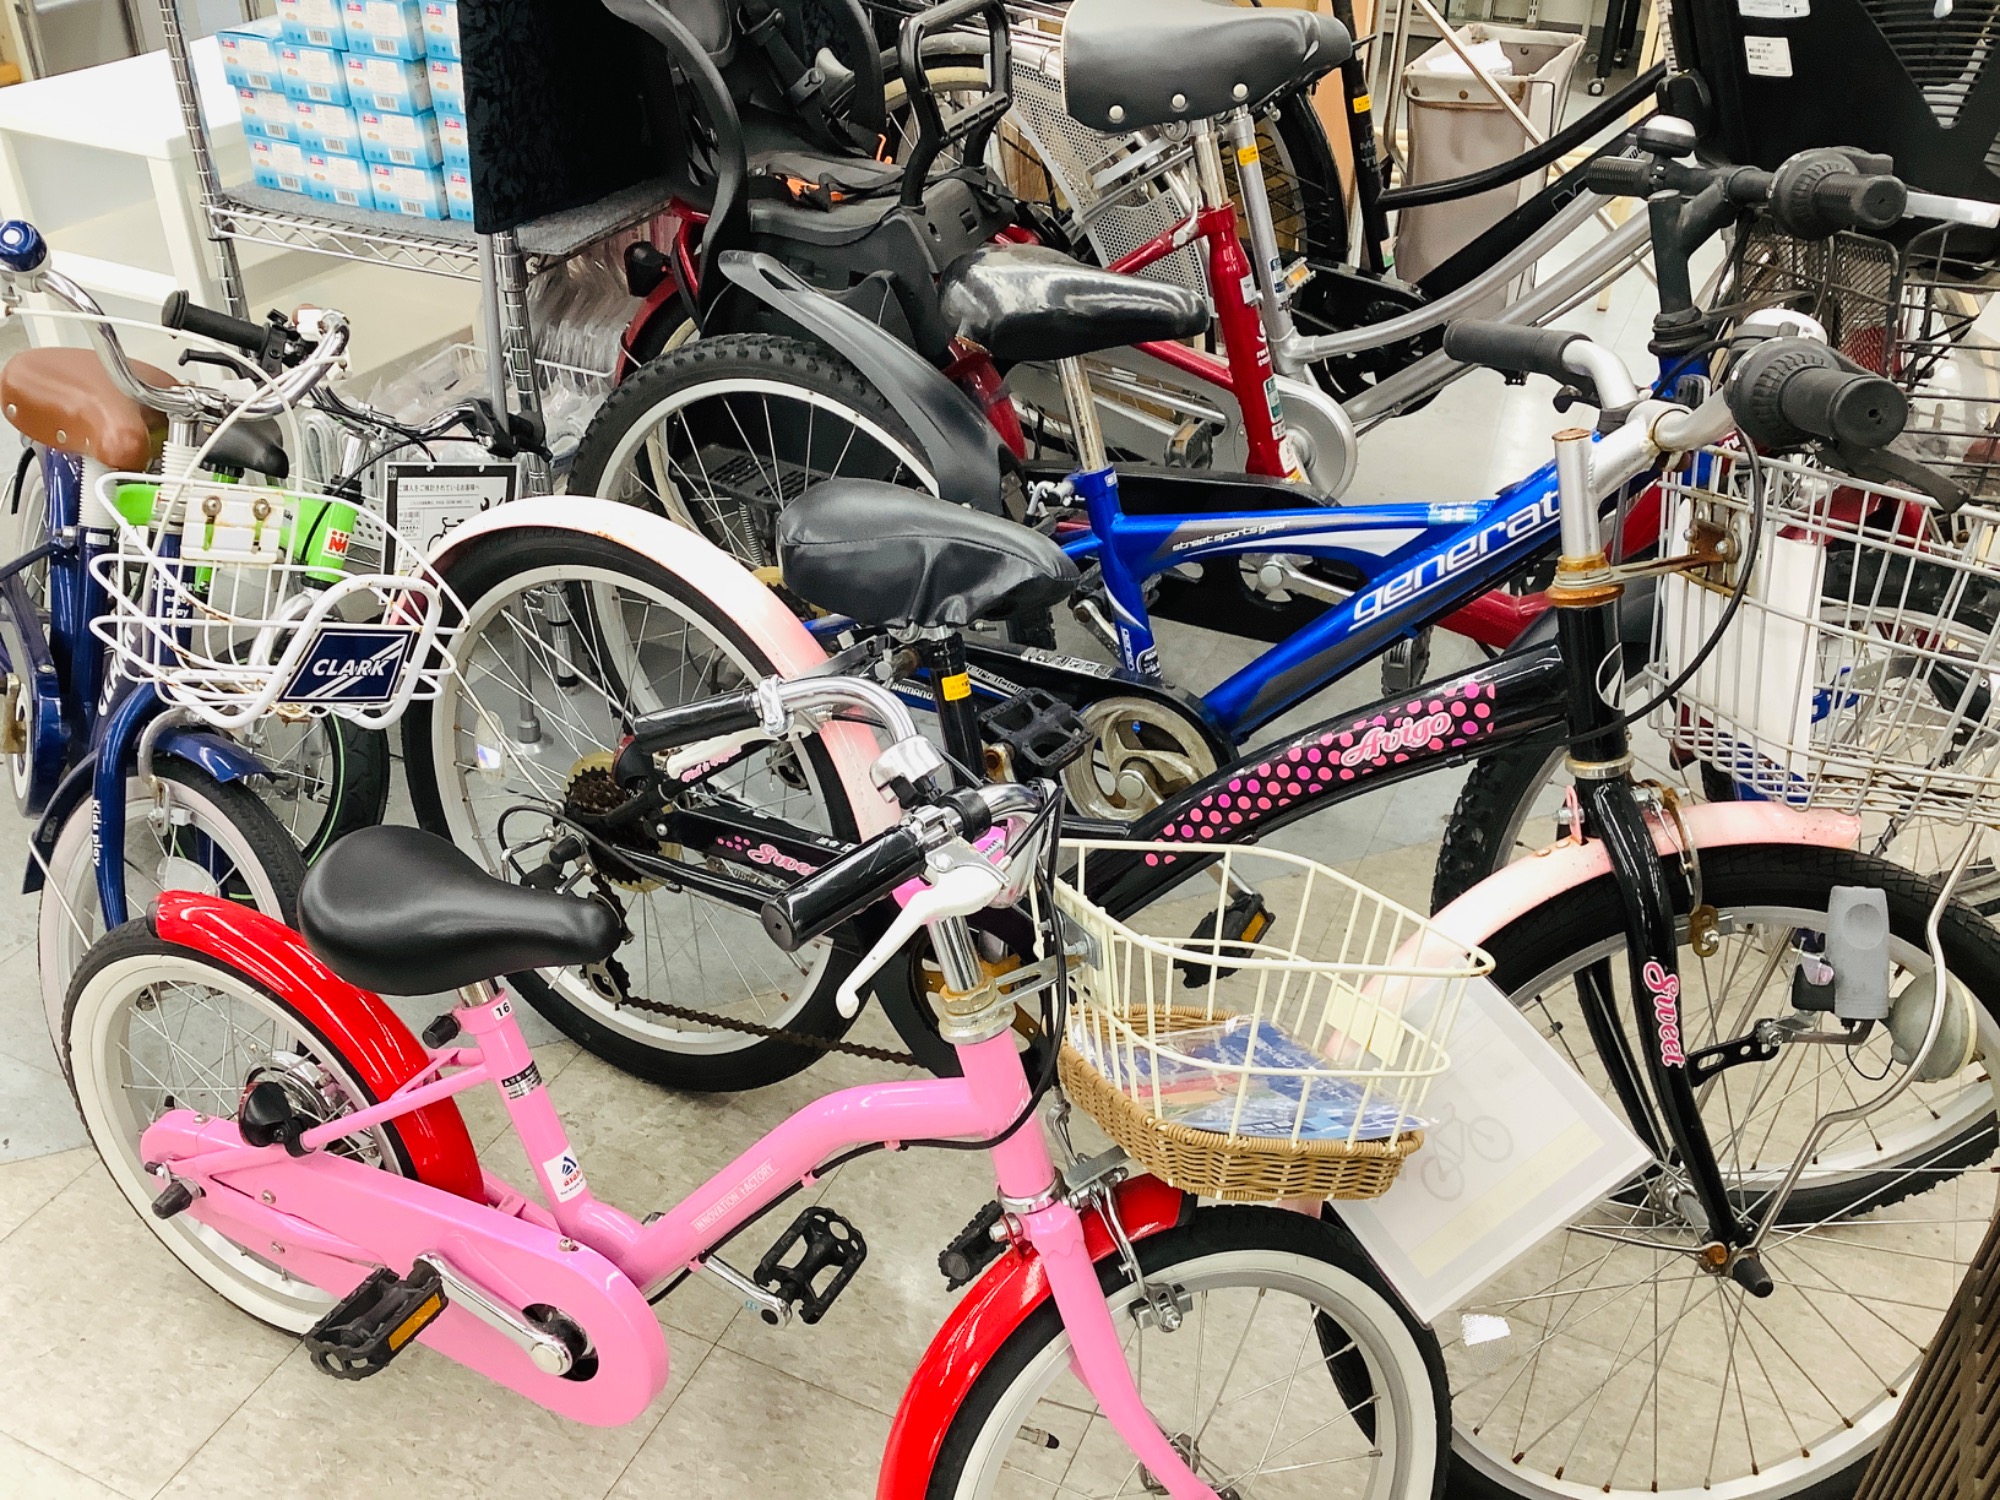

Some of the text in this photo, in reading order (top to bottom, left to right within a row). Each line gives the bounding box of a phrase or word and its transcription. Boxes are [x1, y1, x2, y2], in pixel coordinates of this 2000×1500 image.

[1172, 521, 1290, 551] street sports gear
[1353, 490, 1559, 621] generat
[165, 607, 189, 618] pay
[312, 658, 390, 677] CLARK
[1341, 712, 1452, 767] Avigo
[92, 800, 103, 867] Kids play
[747, 843, 822, 876] Swee
[495, 1002, 511, 1017] 16
[1643, 961, 1685, 1068] Sweet
[693, 1162, 774, 1232] INNOVATION FACTORY
